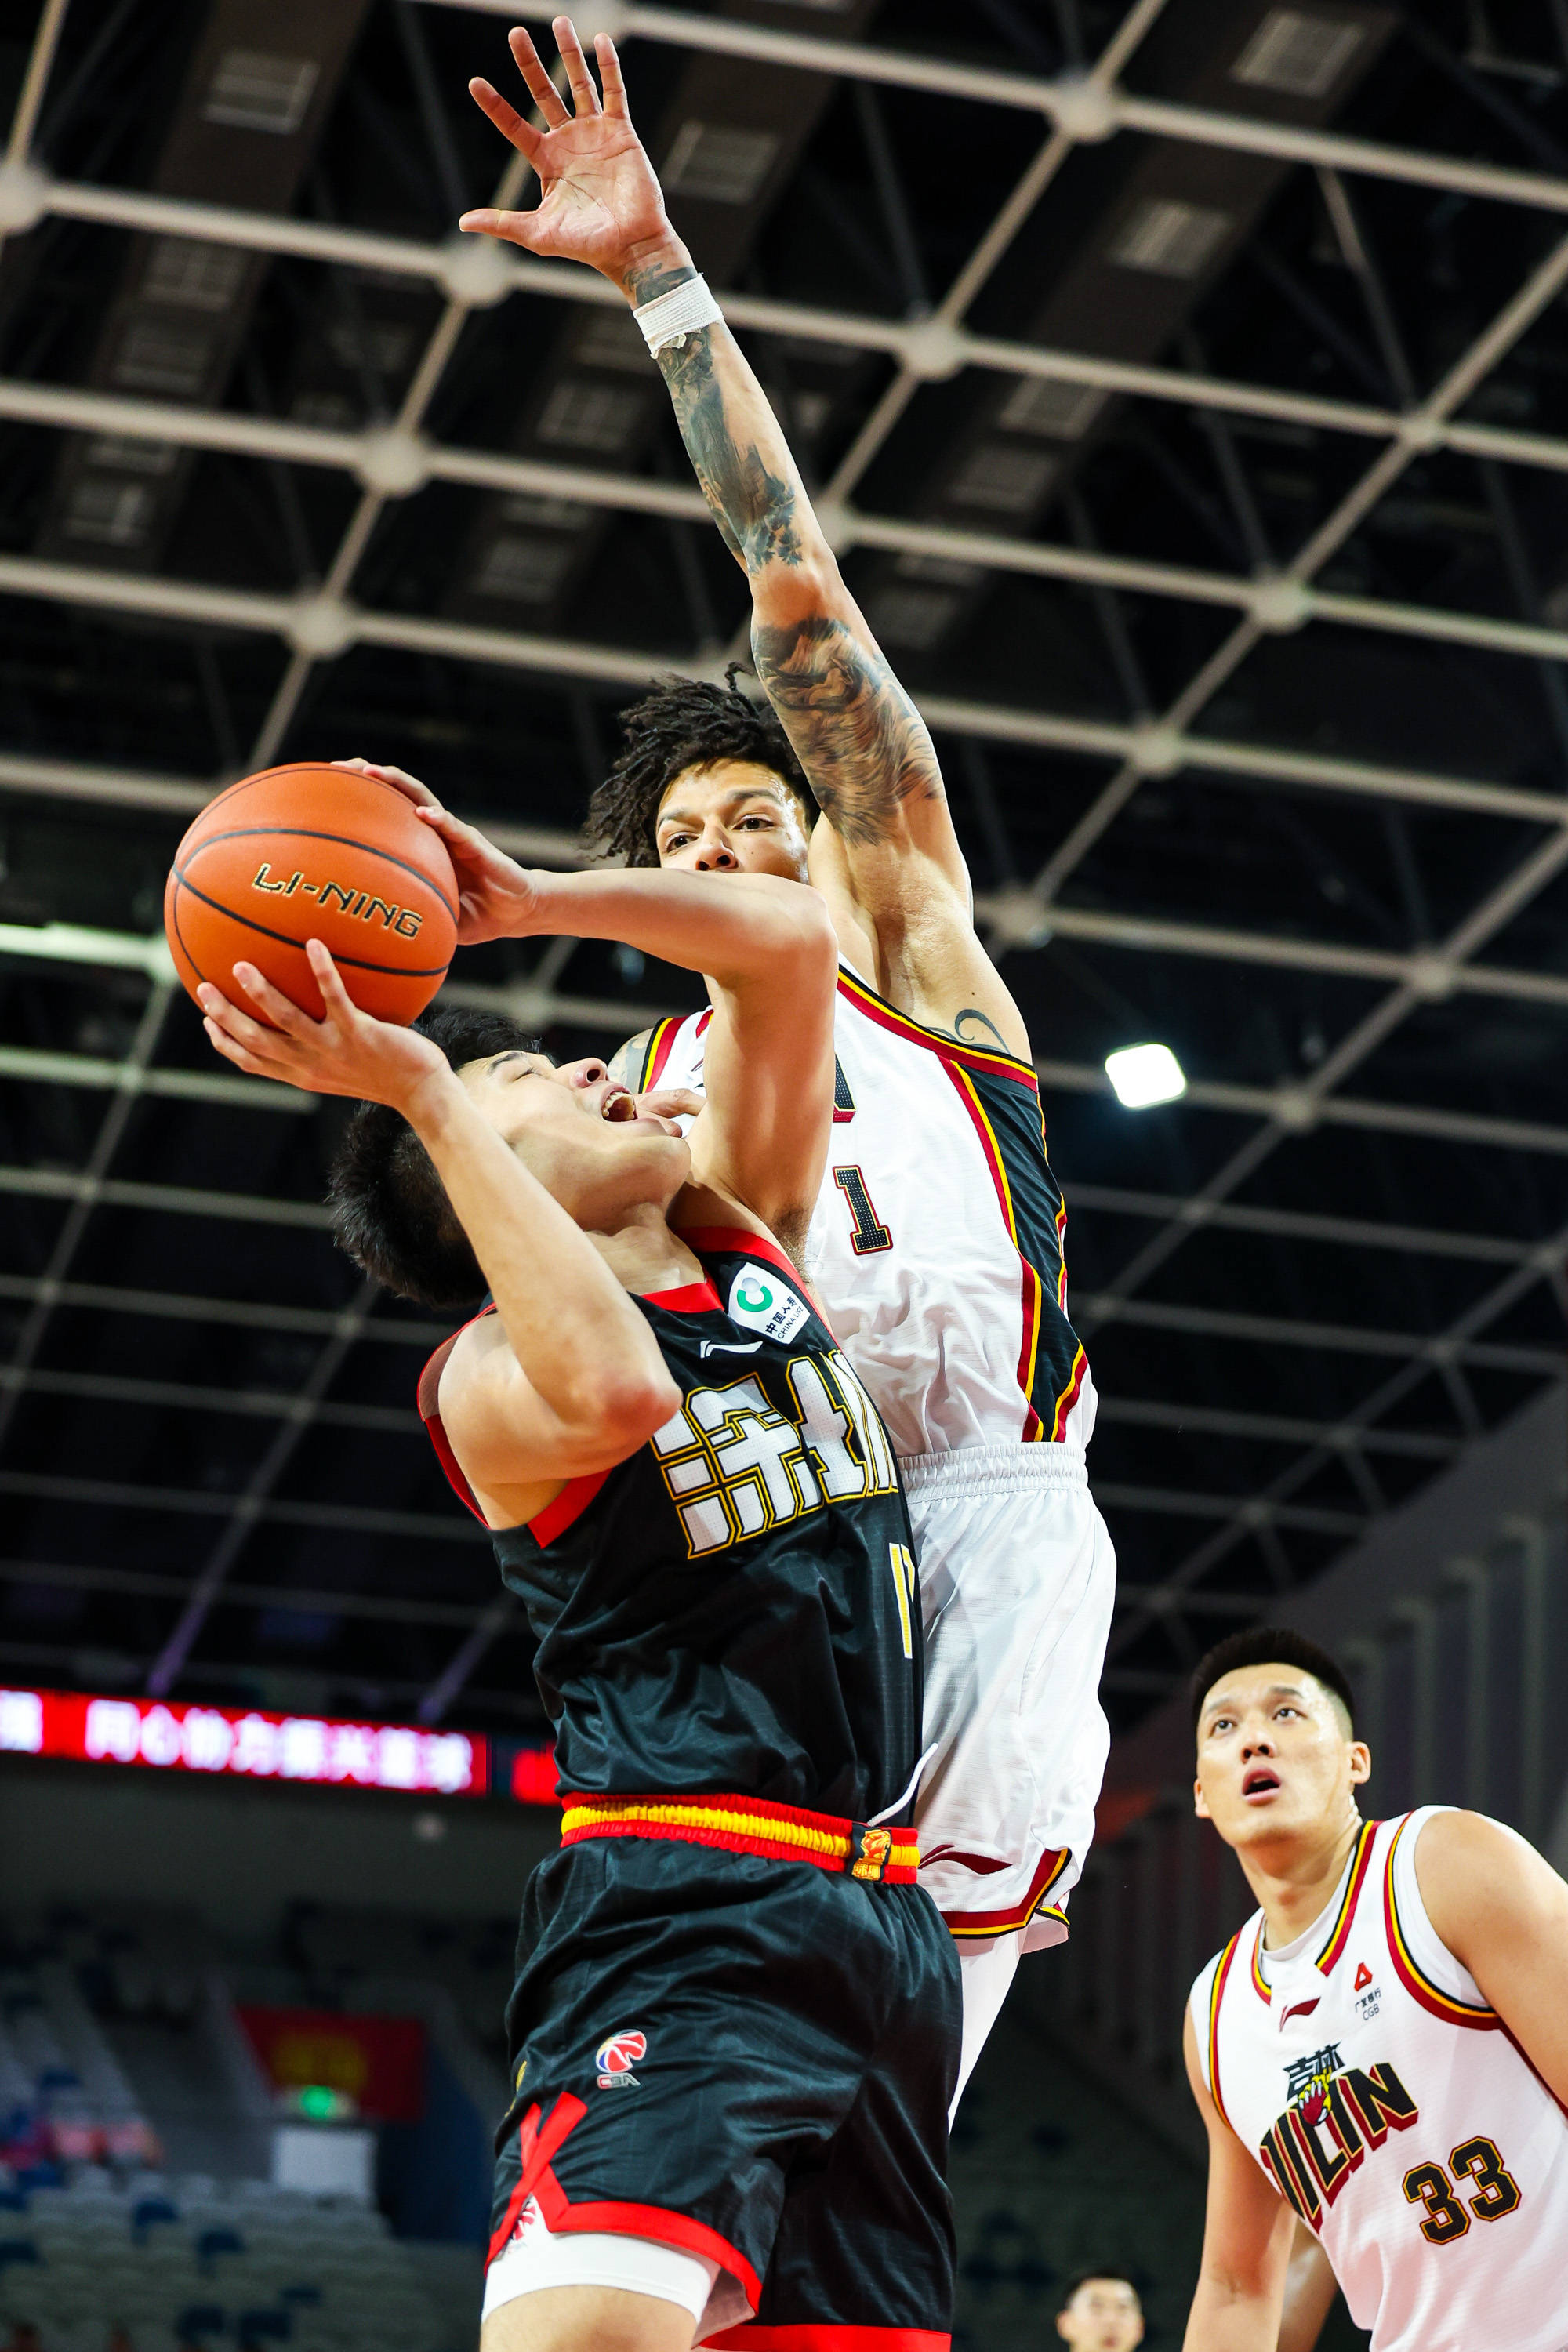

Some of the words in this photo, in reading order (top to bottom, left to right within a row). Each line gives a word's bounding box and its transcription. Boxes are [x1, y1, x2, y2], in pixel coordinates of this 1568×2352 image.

[251, 862, 423, 940] LI-NING
[833, 1165, 893, 1255] 1
[777, 1317, 797, 1339] CHINA
[1363, 2003, 1380, 2021] CGB
[597, 2073, 641, 2090] CBA
[1403, 2135, 1523, 2245] 33
